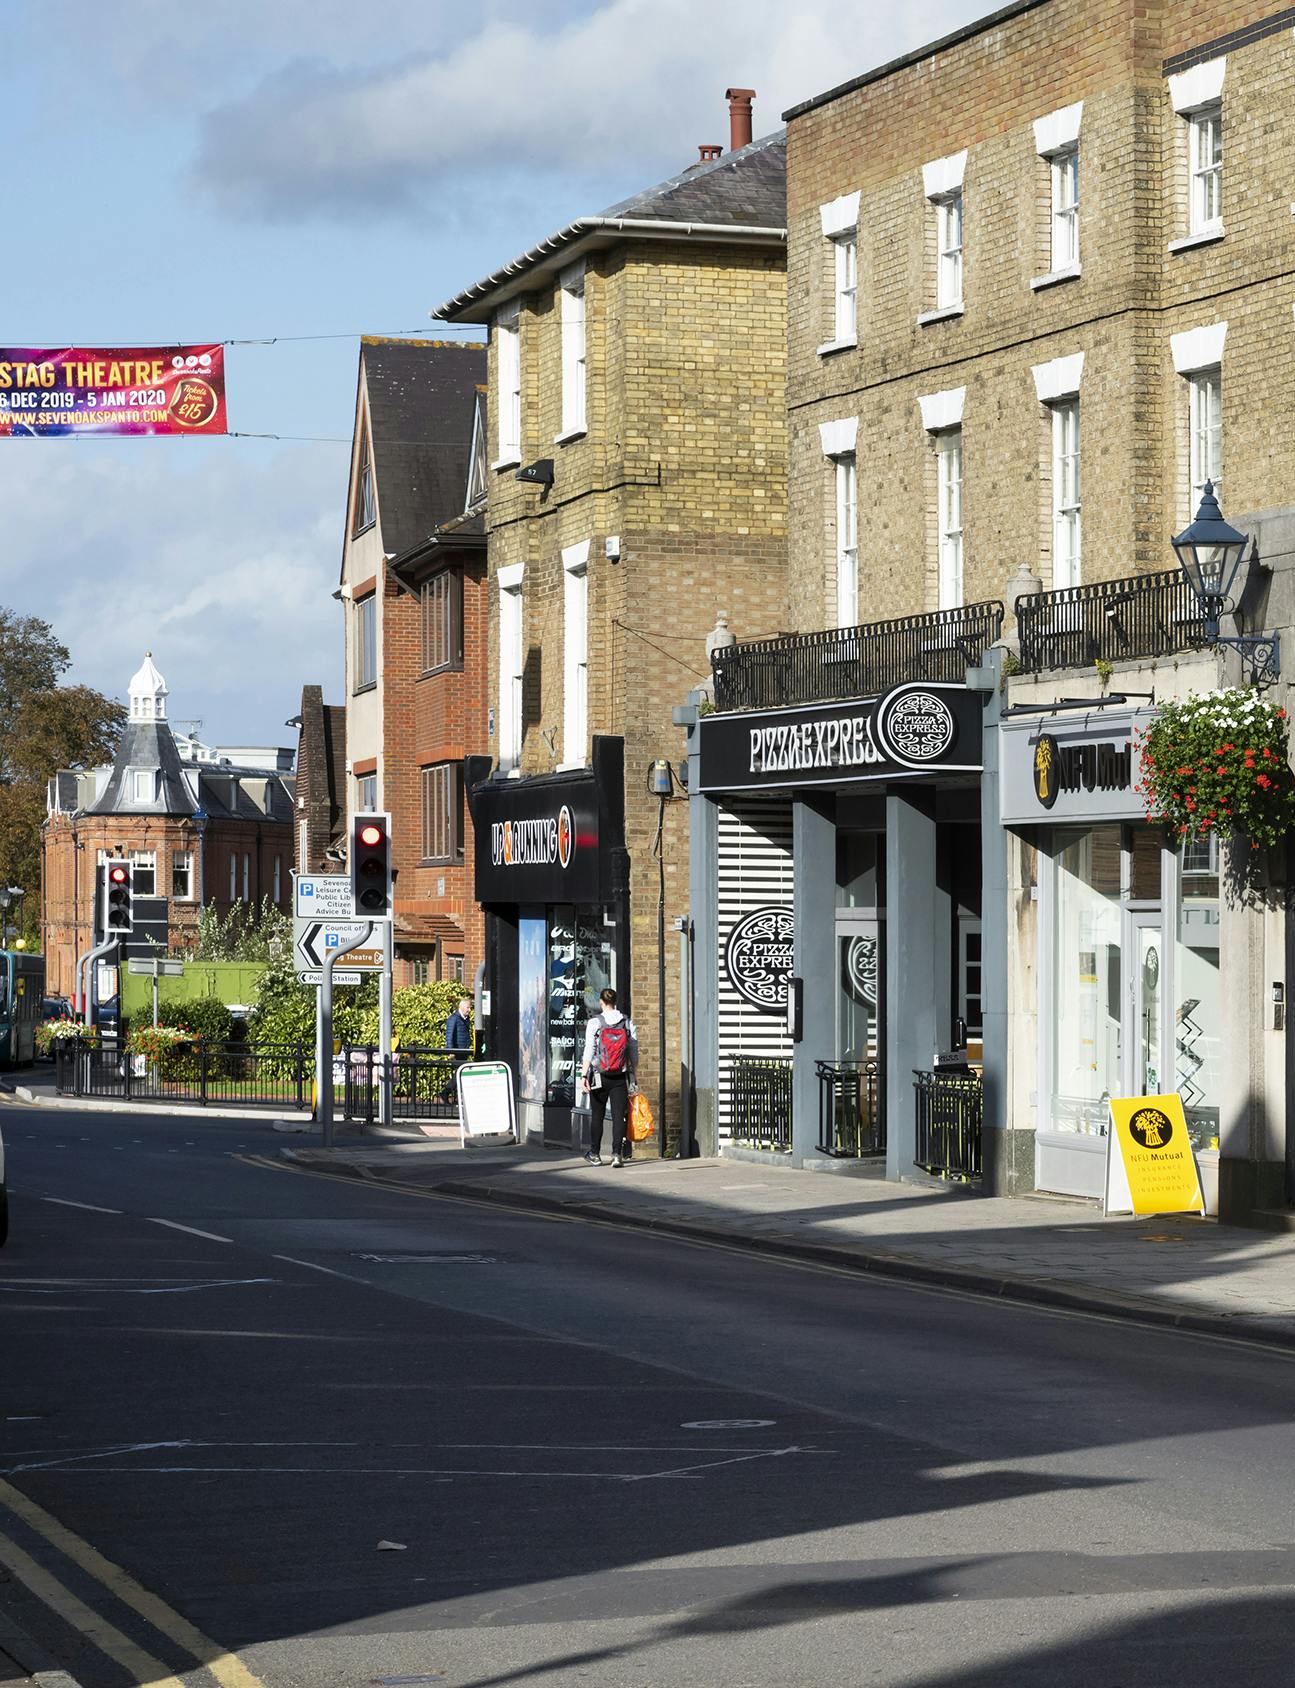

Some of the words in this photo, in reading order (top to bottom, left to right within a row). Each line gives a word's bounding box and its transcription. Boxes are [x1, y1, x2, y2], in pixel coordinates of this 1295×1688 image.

[0, 362, 55, 388] STAG
[61, 361, 164, 388] THEATRE
[11, 392, 38, 408] DEC
[41, 392, 74, 408] 2019
[87, 392, 97, 408] 5
[100, 391, 126, 407] JAN
[129, 389, 166, 406] 2020
[178, 403, 206, 419] £15
[0, 410, 168, 425] WWW.SEVENOAKSPANTO.COM
[904, 716, 937, 725] PIZZA
[895, 725, 946, 733] EXPRESS
[750, 715, 887, 772] PIZZAEXPRES
[303, 884, 312, 895] P
[328, 935, 337, 946] P
[346, 953, 373, 961] Theatre
[1130, 1154, 1149, 1162] NFU
[1151, 1152, 1184, 1161] Mutual
